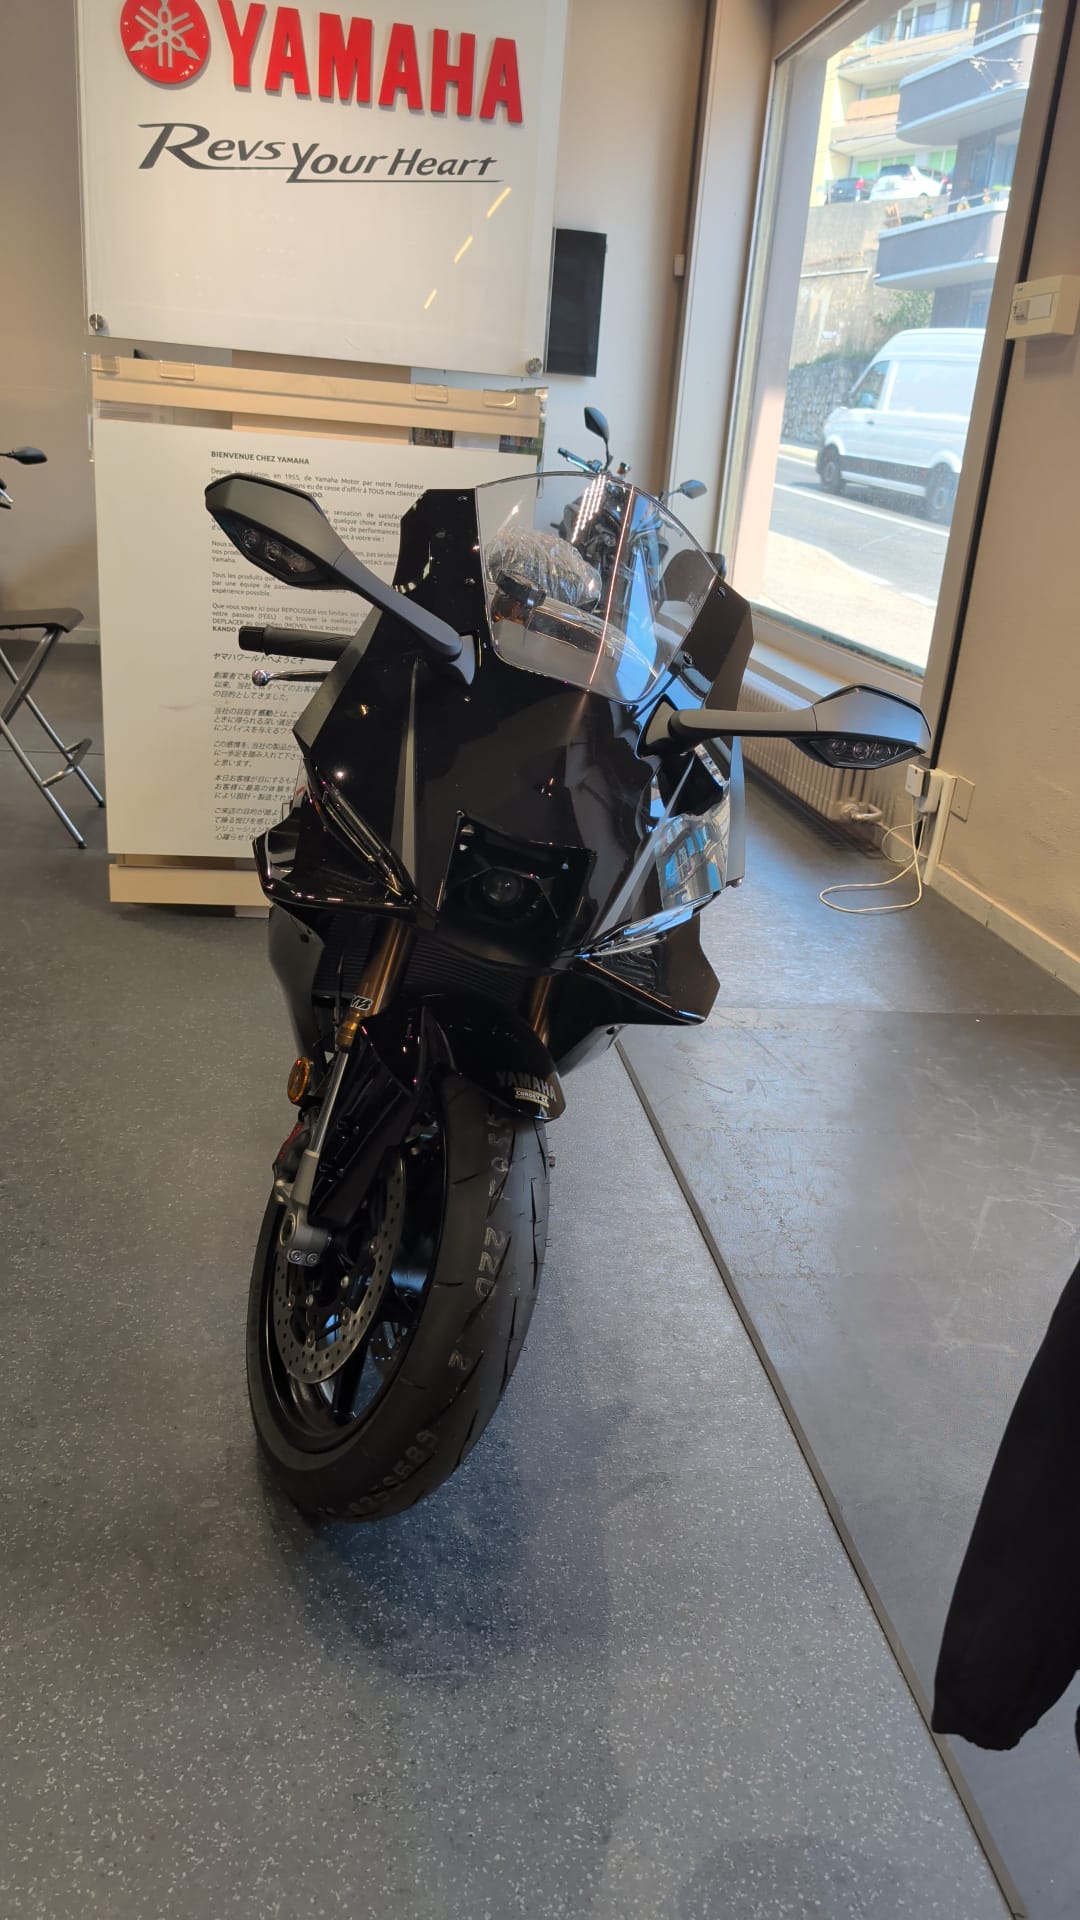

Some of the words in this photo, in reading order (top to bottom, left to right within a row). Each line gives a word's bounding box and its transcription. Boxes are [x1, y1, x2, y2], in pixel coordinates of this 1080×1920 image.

[217, 0, 523, 123] YAMAHA
[138, 122, 288, 171] Revs
[287, 143, 387, 183] Your
[387, 148, 499, 178] Heart
[211, 450, 254, 461] BIENVENUE
[256, 454, 275, 463] CHEZ
[277, 456, 310, 465] YAMAHA
[315, 476, 338, 484] Yamaha
[395, 482, 424, 490] fondateur
[368, 488, 385, 496] TOUS
[379, 512, 401, 520] satisfac
[378, 520, 400, 531] d'excep
[495, 1072, 558, 1103] YAMAHA
